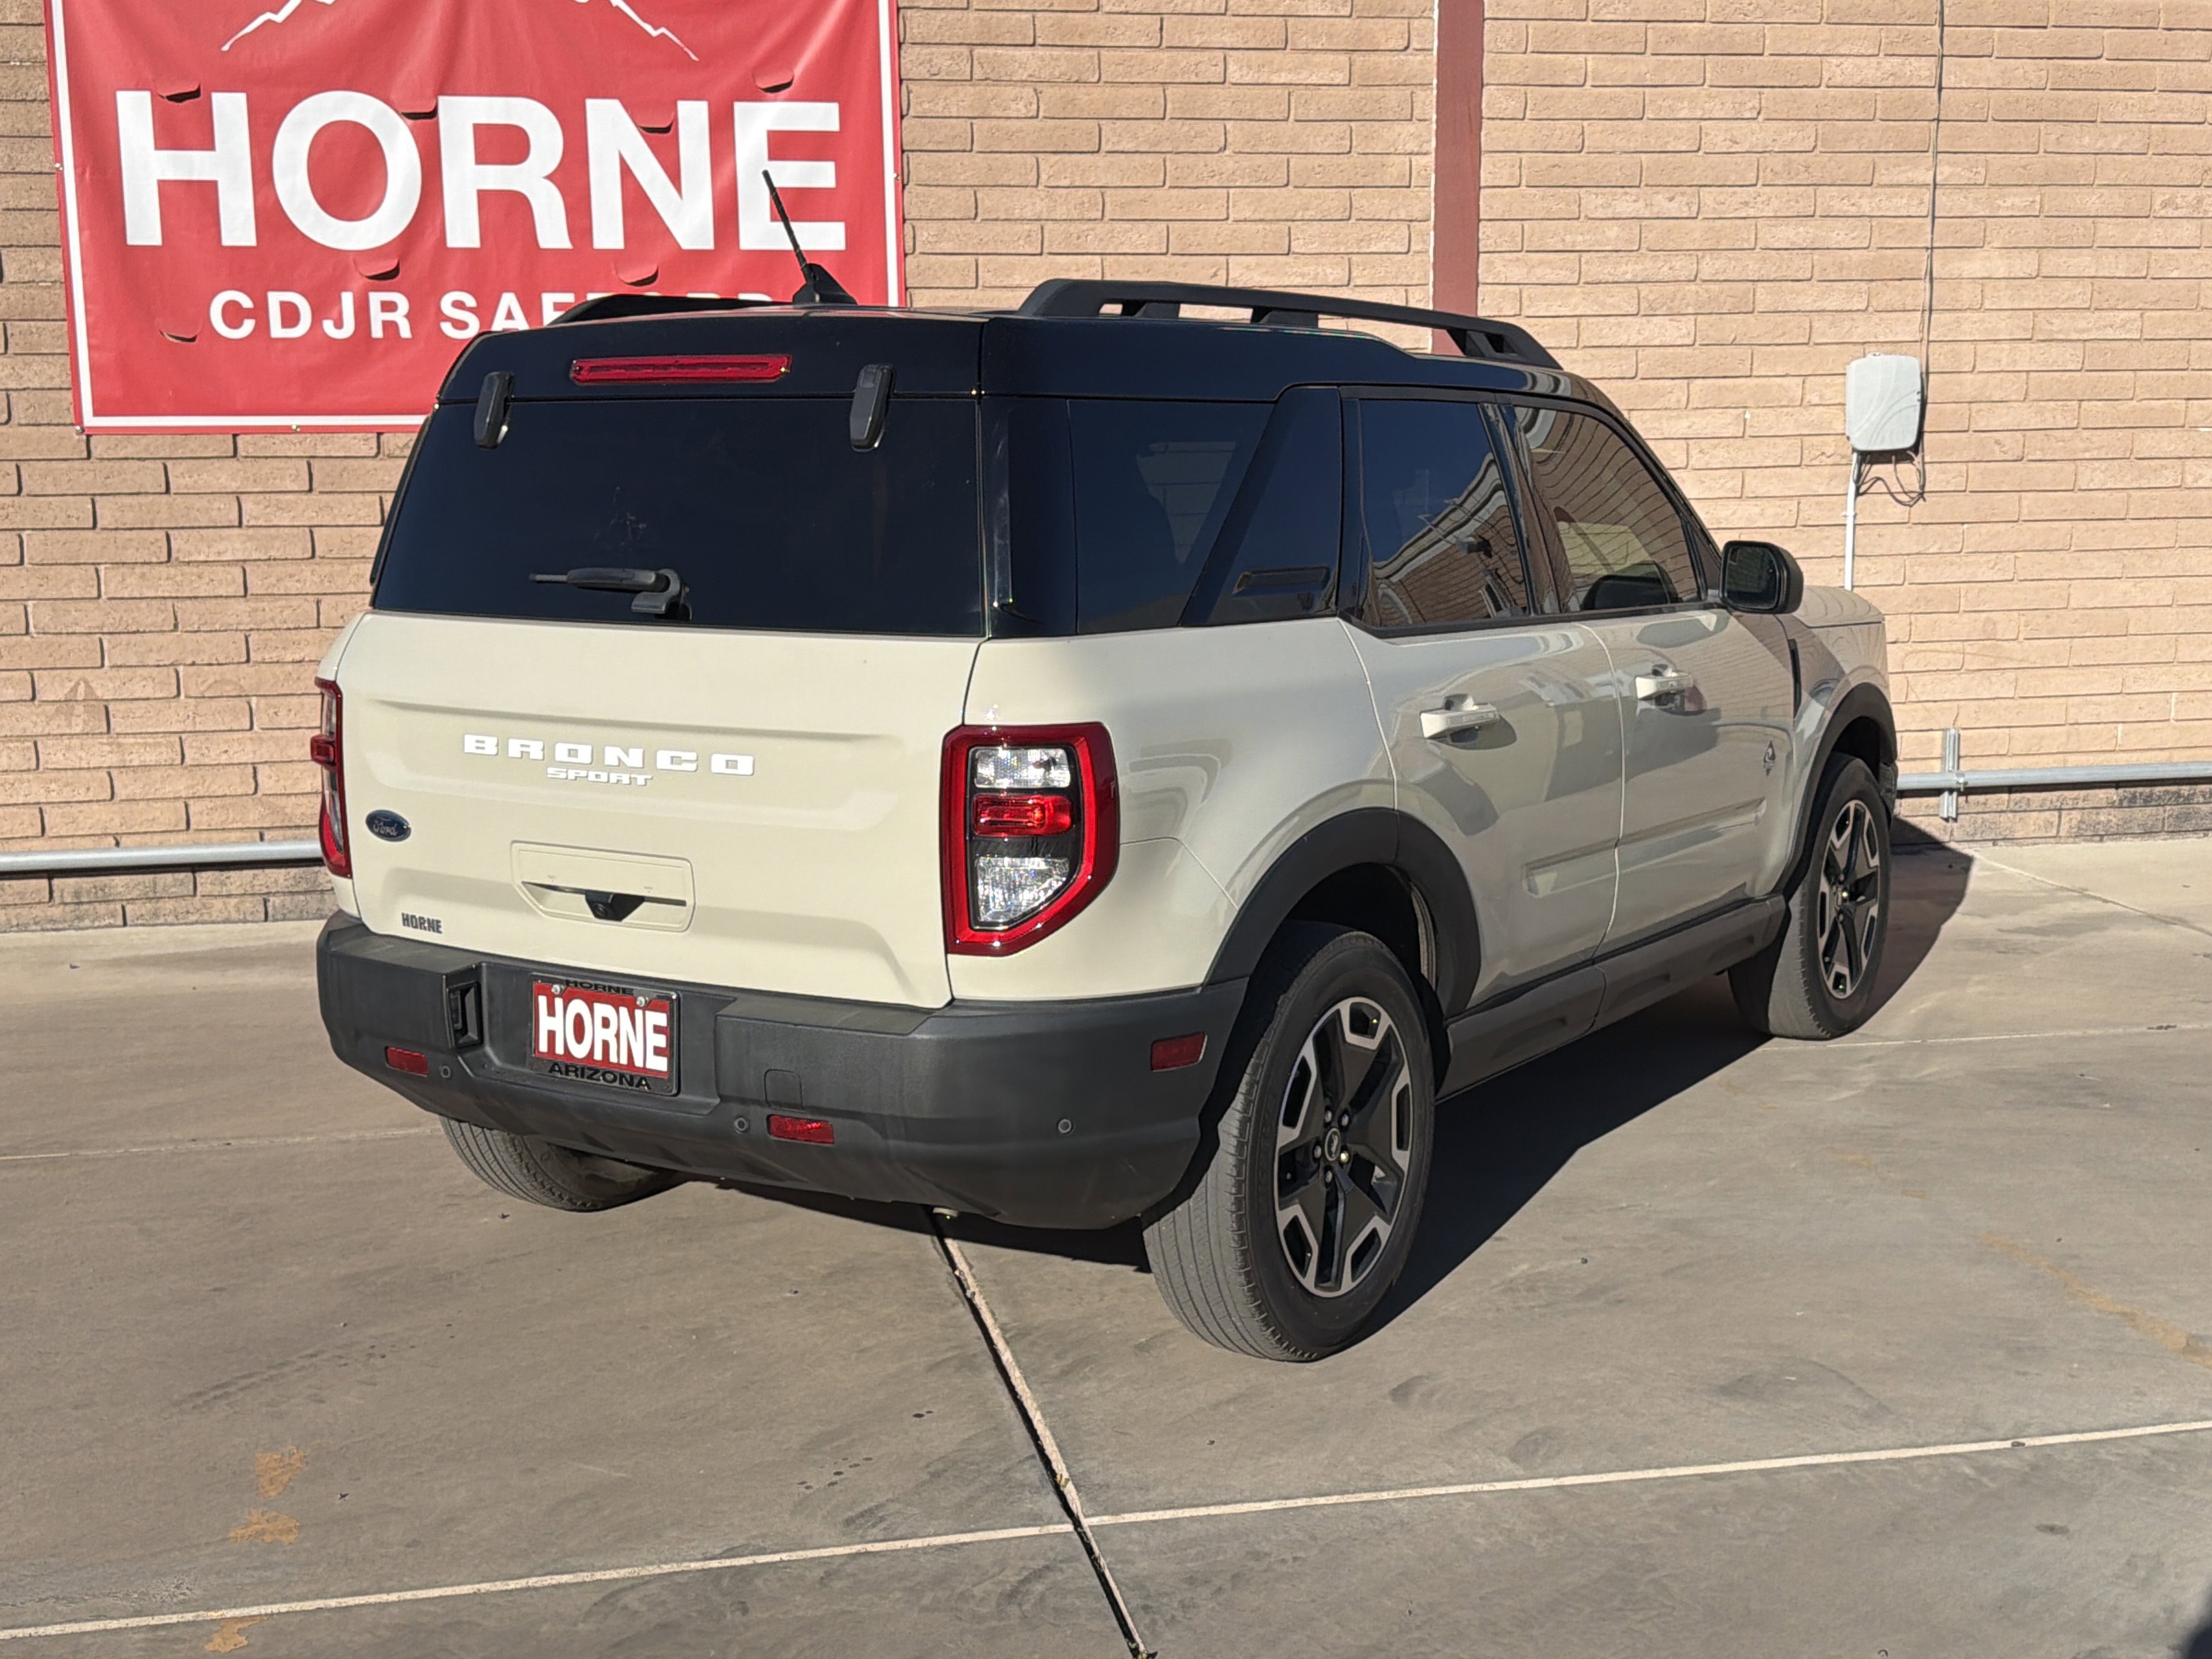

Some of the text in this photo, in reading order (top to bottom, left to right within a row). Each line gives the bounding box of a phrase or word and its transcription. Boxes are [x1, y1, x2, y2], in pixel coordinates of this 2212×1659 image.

[115, 89, 847, 252] HORNE
[208, 289, 412, 340] CDJR
[464, 735, 754, 776] BRONCO
[546, 767, 653, 786] SPORT
[373, 816, 398, 836] Ford
[402, 912, 443, 934] HORNE
[565, 979, 634, 996] HORNE
[537, 994, 668, 1072] HORNE
[548, 1062, 651, 1091] ARIZONA
